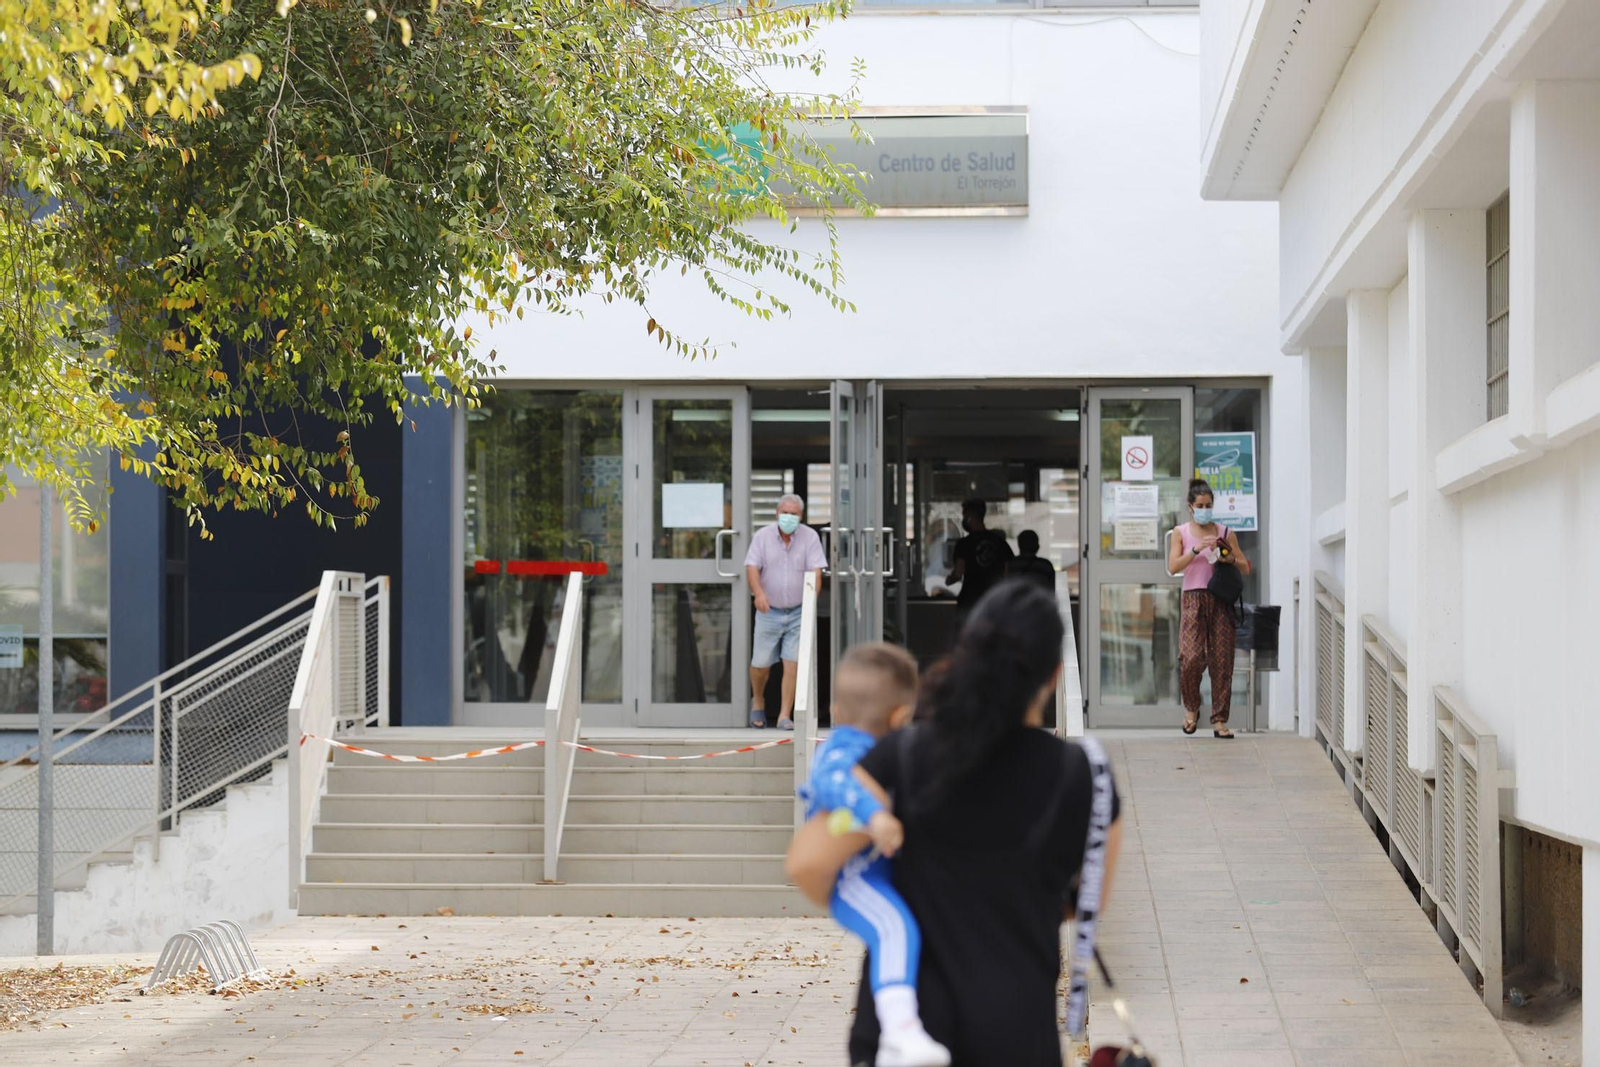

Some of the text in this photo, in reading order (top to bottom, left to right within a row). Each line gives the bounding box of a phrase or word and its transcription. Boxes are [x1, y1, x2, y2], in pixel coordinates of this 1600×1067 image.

[879, 151, 1016, 172] Centro de Salud
[958, 174, 1016, 191] El Torrejón
